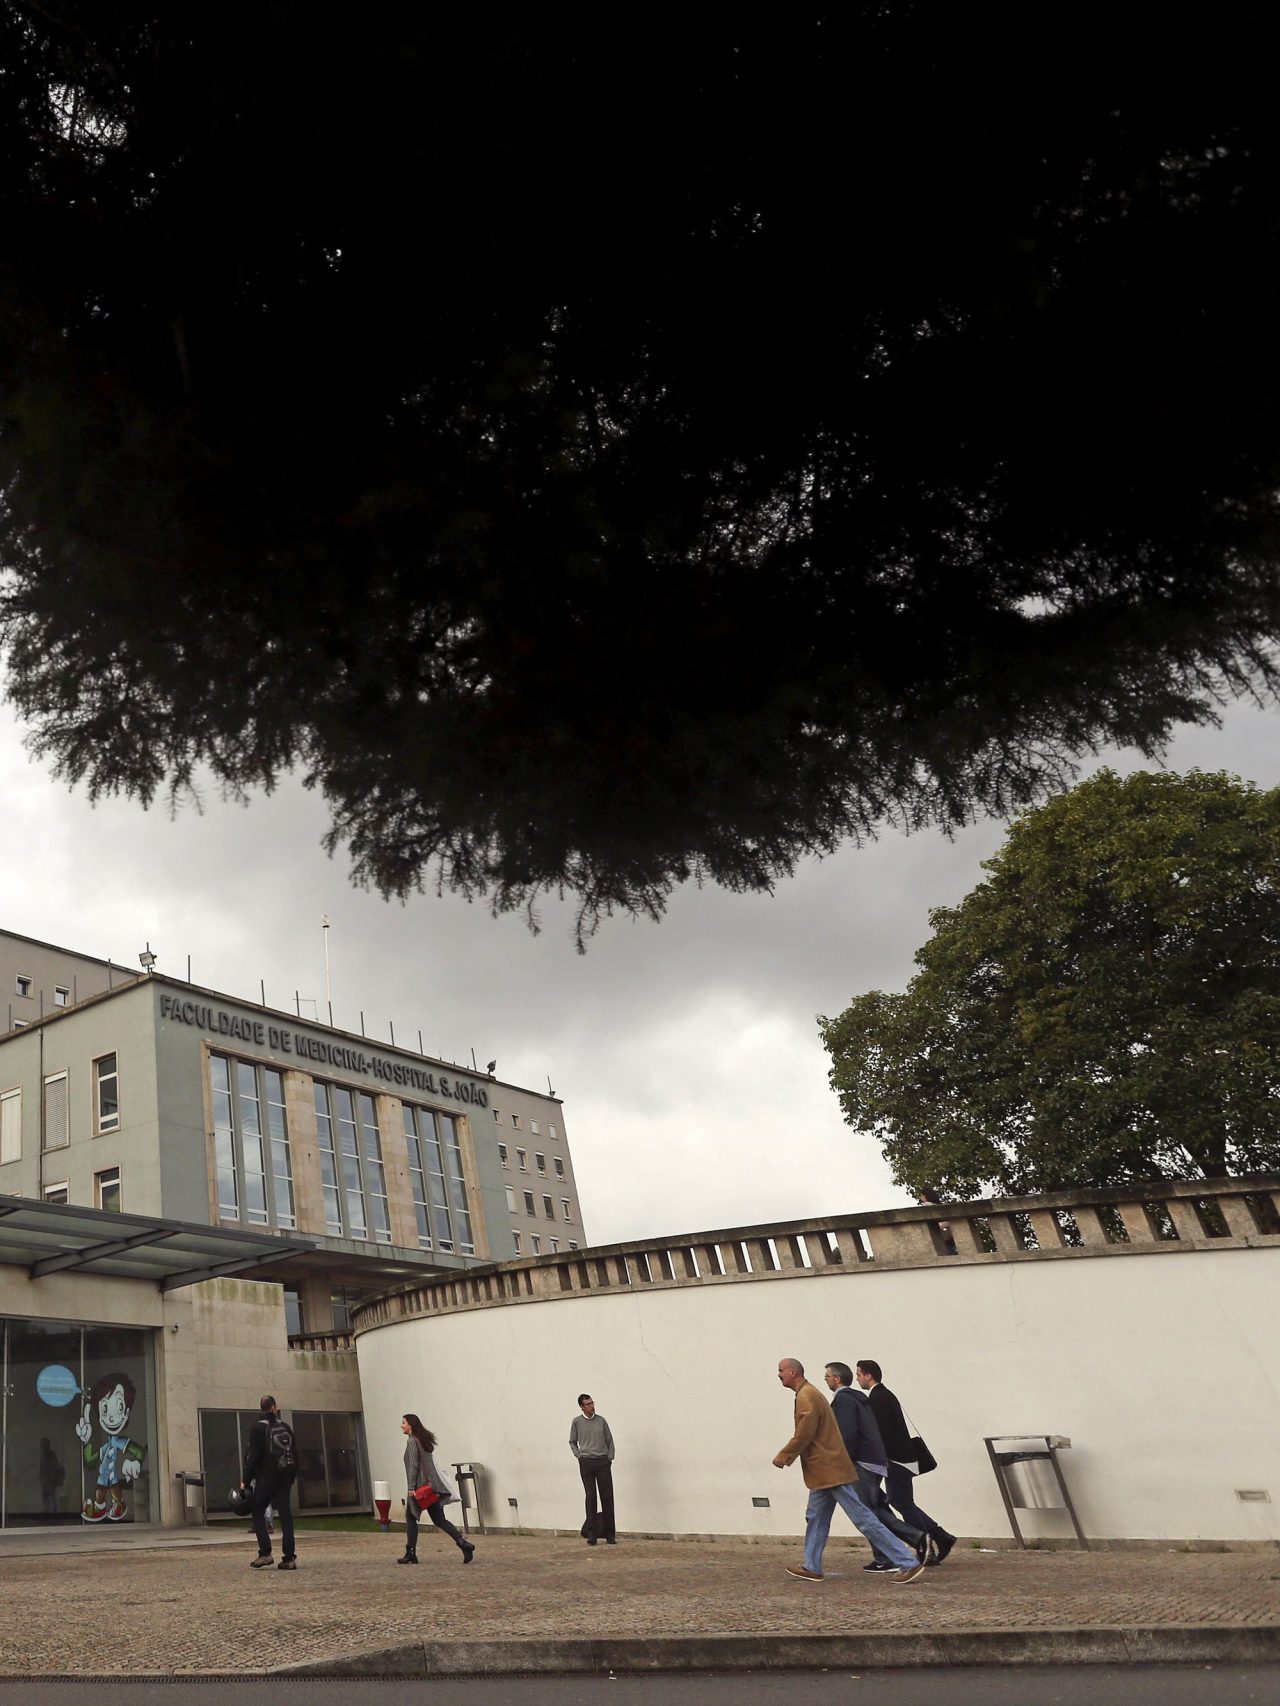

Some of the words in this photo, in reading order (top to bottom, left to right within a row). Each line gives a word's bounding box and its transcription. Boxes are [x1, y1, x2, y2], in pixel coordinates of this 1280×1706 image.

[160, 994, 265, 1045] FACULDADE
[268, 1026, 292, 1053] DE
[440, 1077, 453, 1098] S.
[454, 1081, 489, 1108] JOÃO
